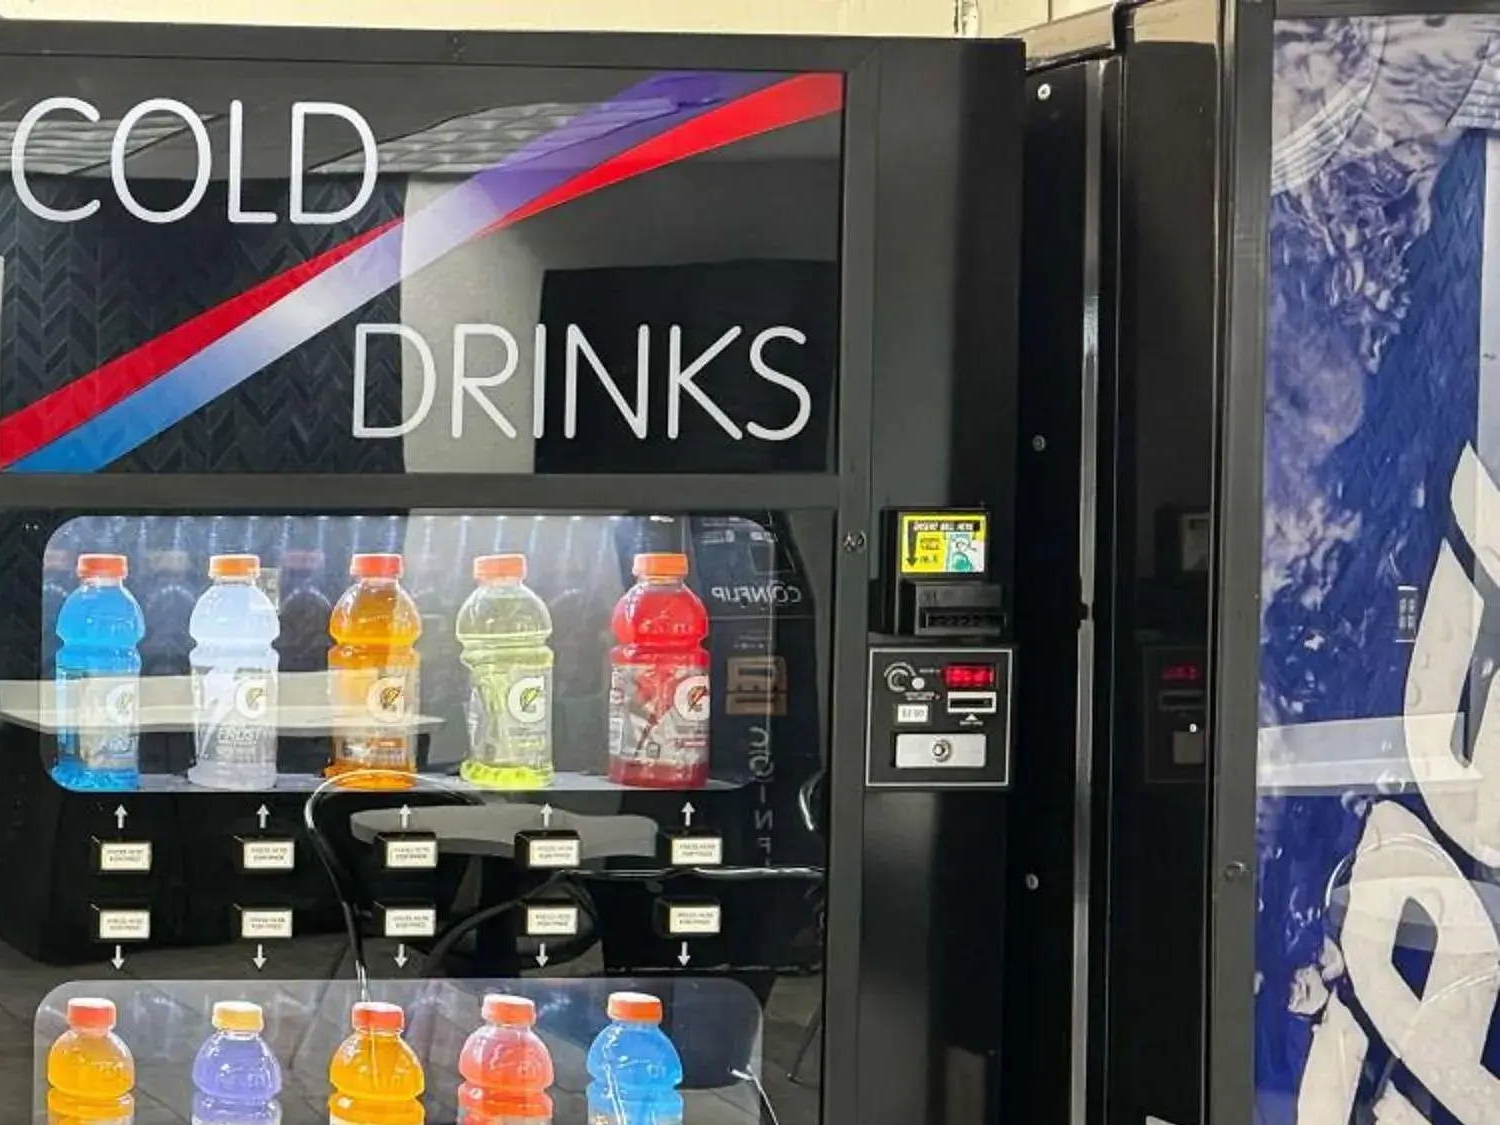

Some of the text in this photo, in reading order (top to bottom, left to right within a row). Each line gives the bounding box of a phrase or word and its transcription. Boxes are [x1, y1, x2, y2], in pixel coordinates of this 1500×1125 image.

[9, 98, 379, 224] COLD
[354, 323, 811, 440] DRINKS
[235, 678, 268, 719] G
[367, 676, 406, 723] G
[507, 676, 547, 723] G
[673, 675, 711, 721] G
